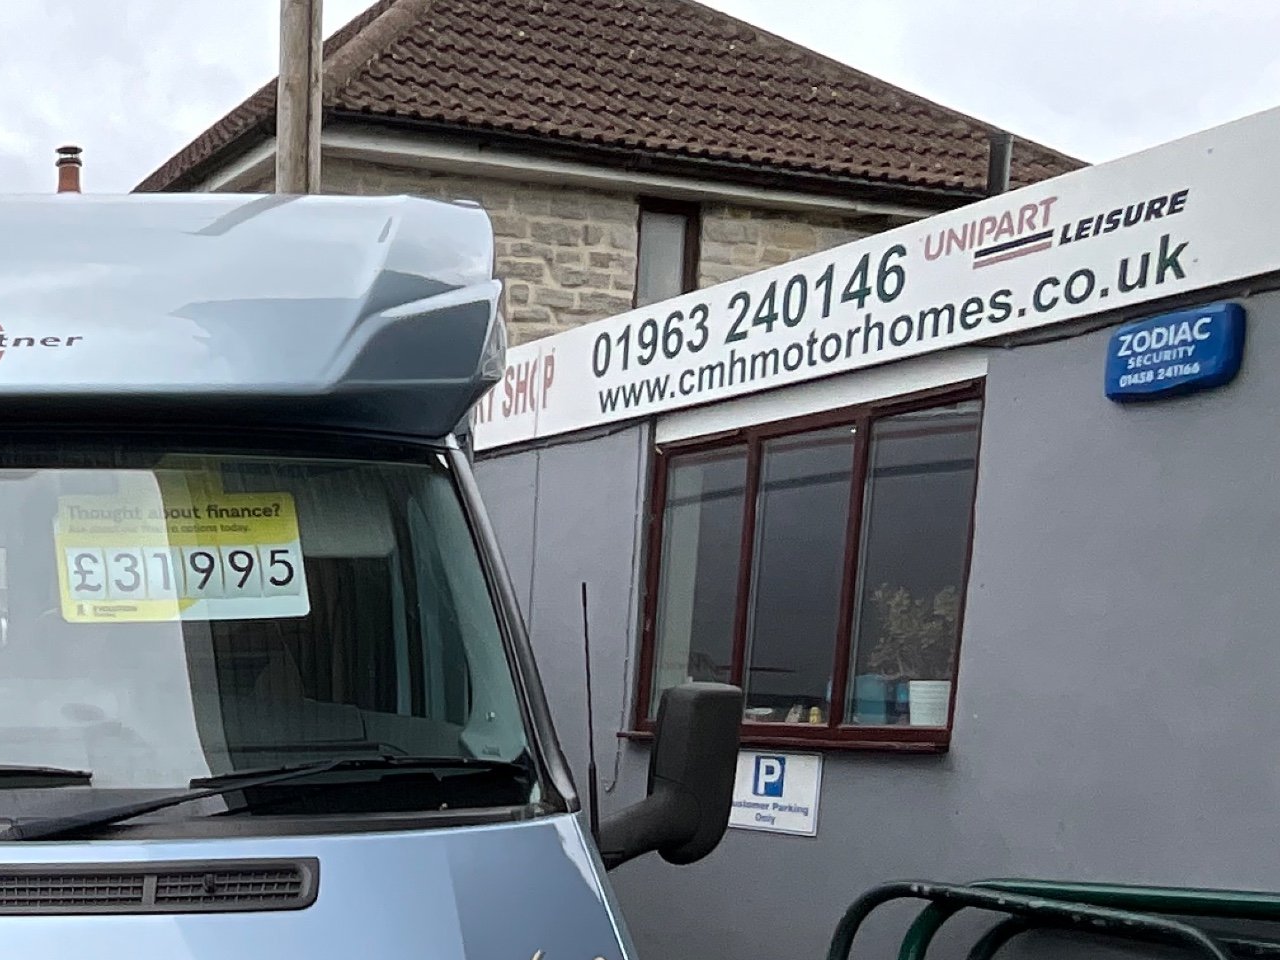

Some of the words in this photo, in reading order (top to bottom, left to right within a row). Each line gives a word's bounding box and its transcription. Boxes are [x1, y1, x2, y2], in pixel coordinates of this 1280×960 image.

[923, 196, 1058, 261] UNIPART
[1059, 188, 1189, 246] LEISURE
[592, 303, 710, 378] 01963
[724, 243, 907, 344] 240146
[598, 233, 1190, 413] www.cmhmotorhomes.co.uk
[1117, 317, 1212, 356] ZODIAC
[1127, 345, 1196, 369] SECURITY
[67, 504, 142, 523] Thought
[207, 503, 280, 519] finance?
[73, 550, 294, 593] £31995
[757, 758, 781, 794] P
[731, 800, 770, 811] ustomer
[772, 802, 809, 817] Parking
